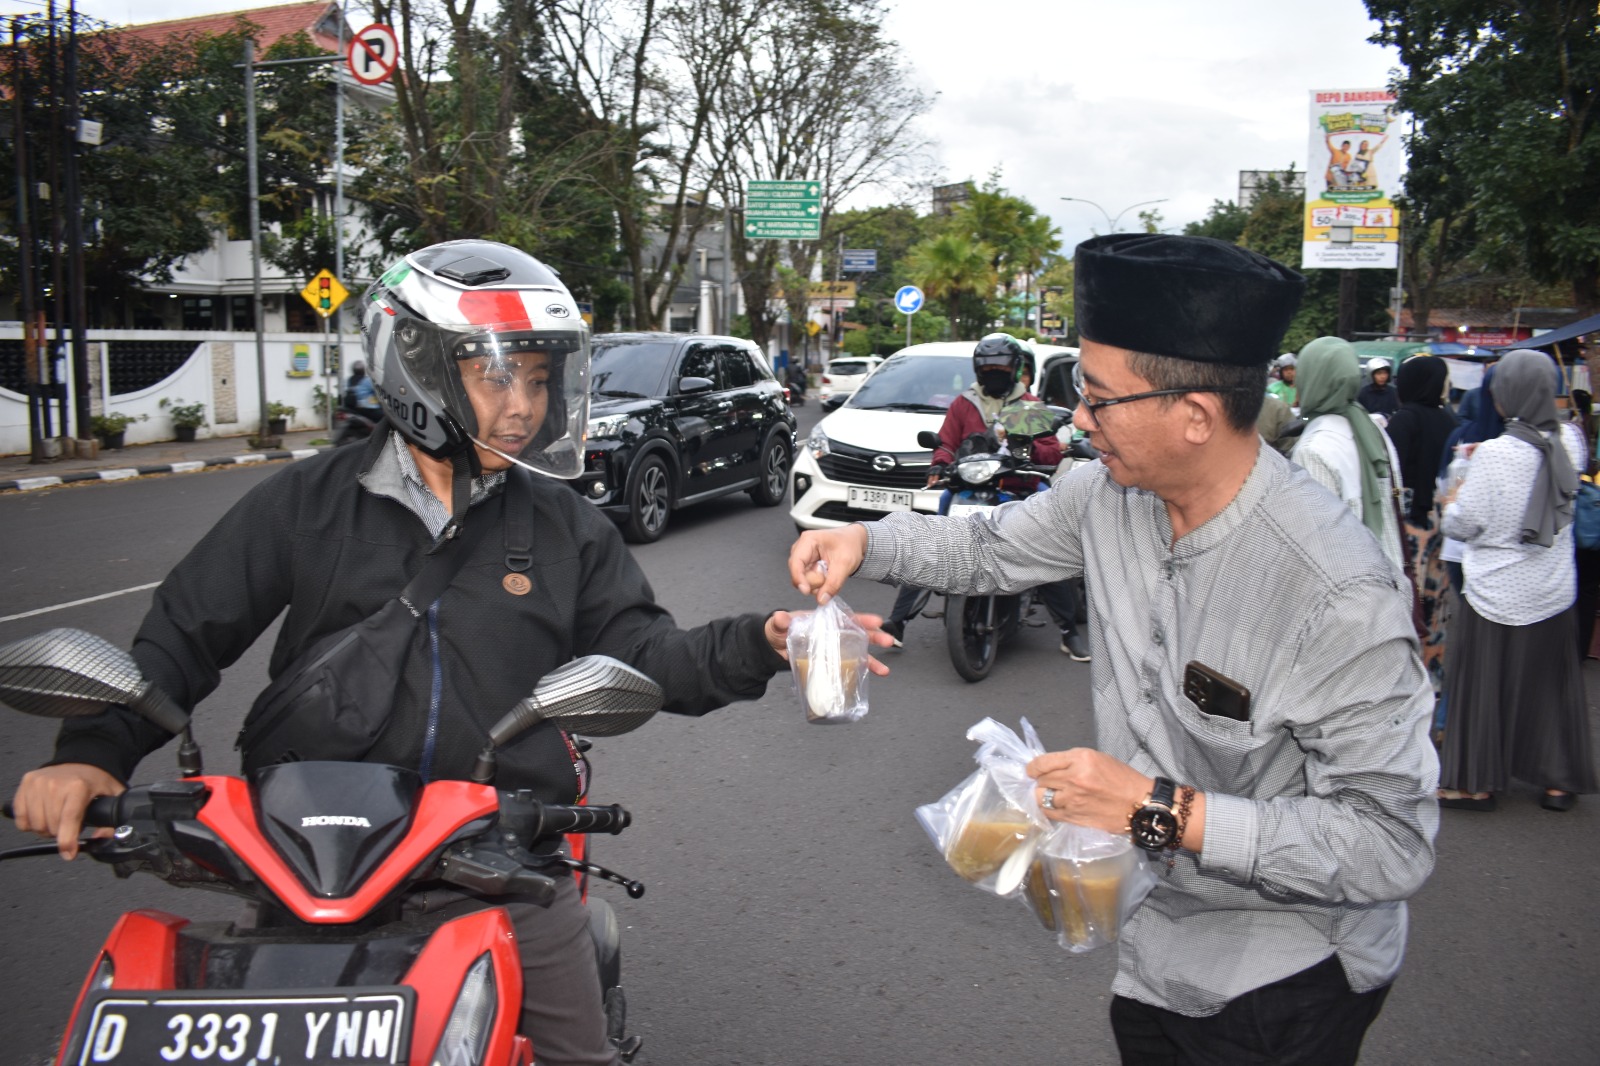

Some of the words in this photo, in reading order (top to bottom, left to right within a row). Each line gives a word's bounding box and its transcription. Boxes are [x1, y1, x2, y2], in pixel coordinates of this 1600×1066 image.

[364, 38, 385, 73] P
[1316, 93, 1341, 103] DEPO
[769, 202, 801, 210] SUBROTO
[851, 489, 858, 501] D
[863, 490, 888, 504] 1389
[301, 815, 372, 828] HONDA
[92, 1013, 128, 1062] D
[160, 1012, 279, 1061] 3331
[304, 1009, 395, 1060] YNN
